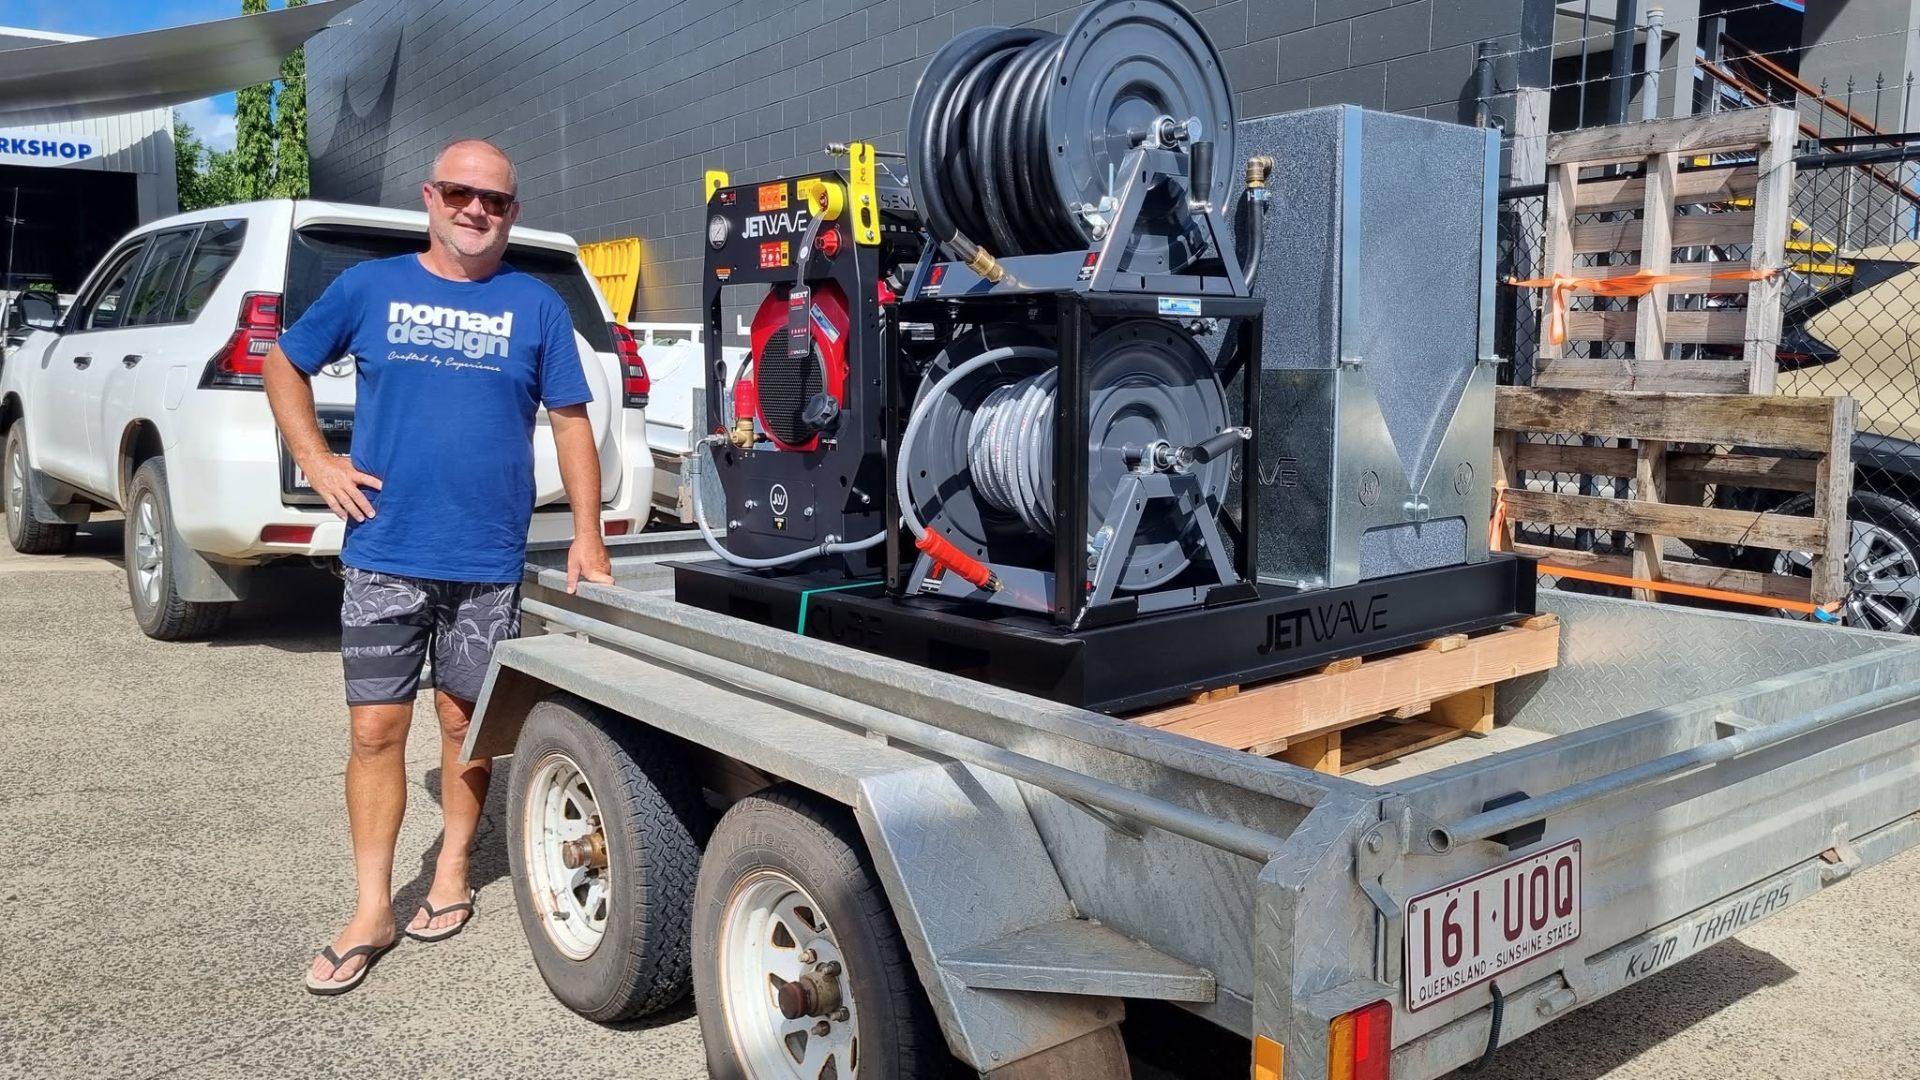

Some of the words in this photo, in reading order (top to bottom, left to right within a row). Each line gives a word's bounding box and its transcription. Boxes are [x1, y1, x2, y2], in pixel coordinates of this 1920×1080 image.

[0, 138, 92, 159] RKSHOP
[881, 194, 916, 210] SEN
[741, 210, 807, 239] JETWAVE
[790, 291, 808, 299] NEXT
[388, 301, 514, 338] nomad
[386, 319, 510, 359] design
[387, 351, 427, 361] Crafted
[430, 355, 442, 367] by
[445, 357, 501, 371] Experience
[1256, 593, 1389, 655] JETWAVE
[1625, 936, 1678, 979] KJM
[1692, 883, 1792, 948] TRAILERS
[1419, 960, 1487, 1001] QUEENSLAND
[1496, 935, 1542, 968] SUNSHINE
[1547, 921, 1573, 945] STATE
